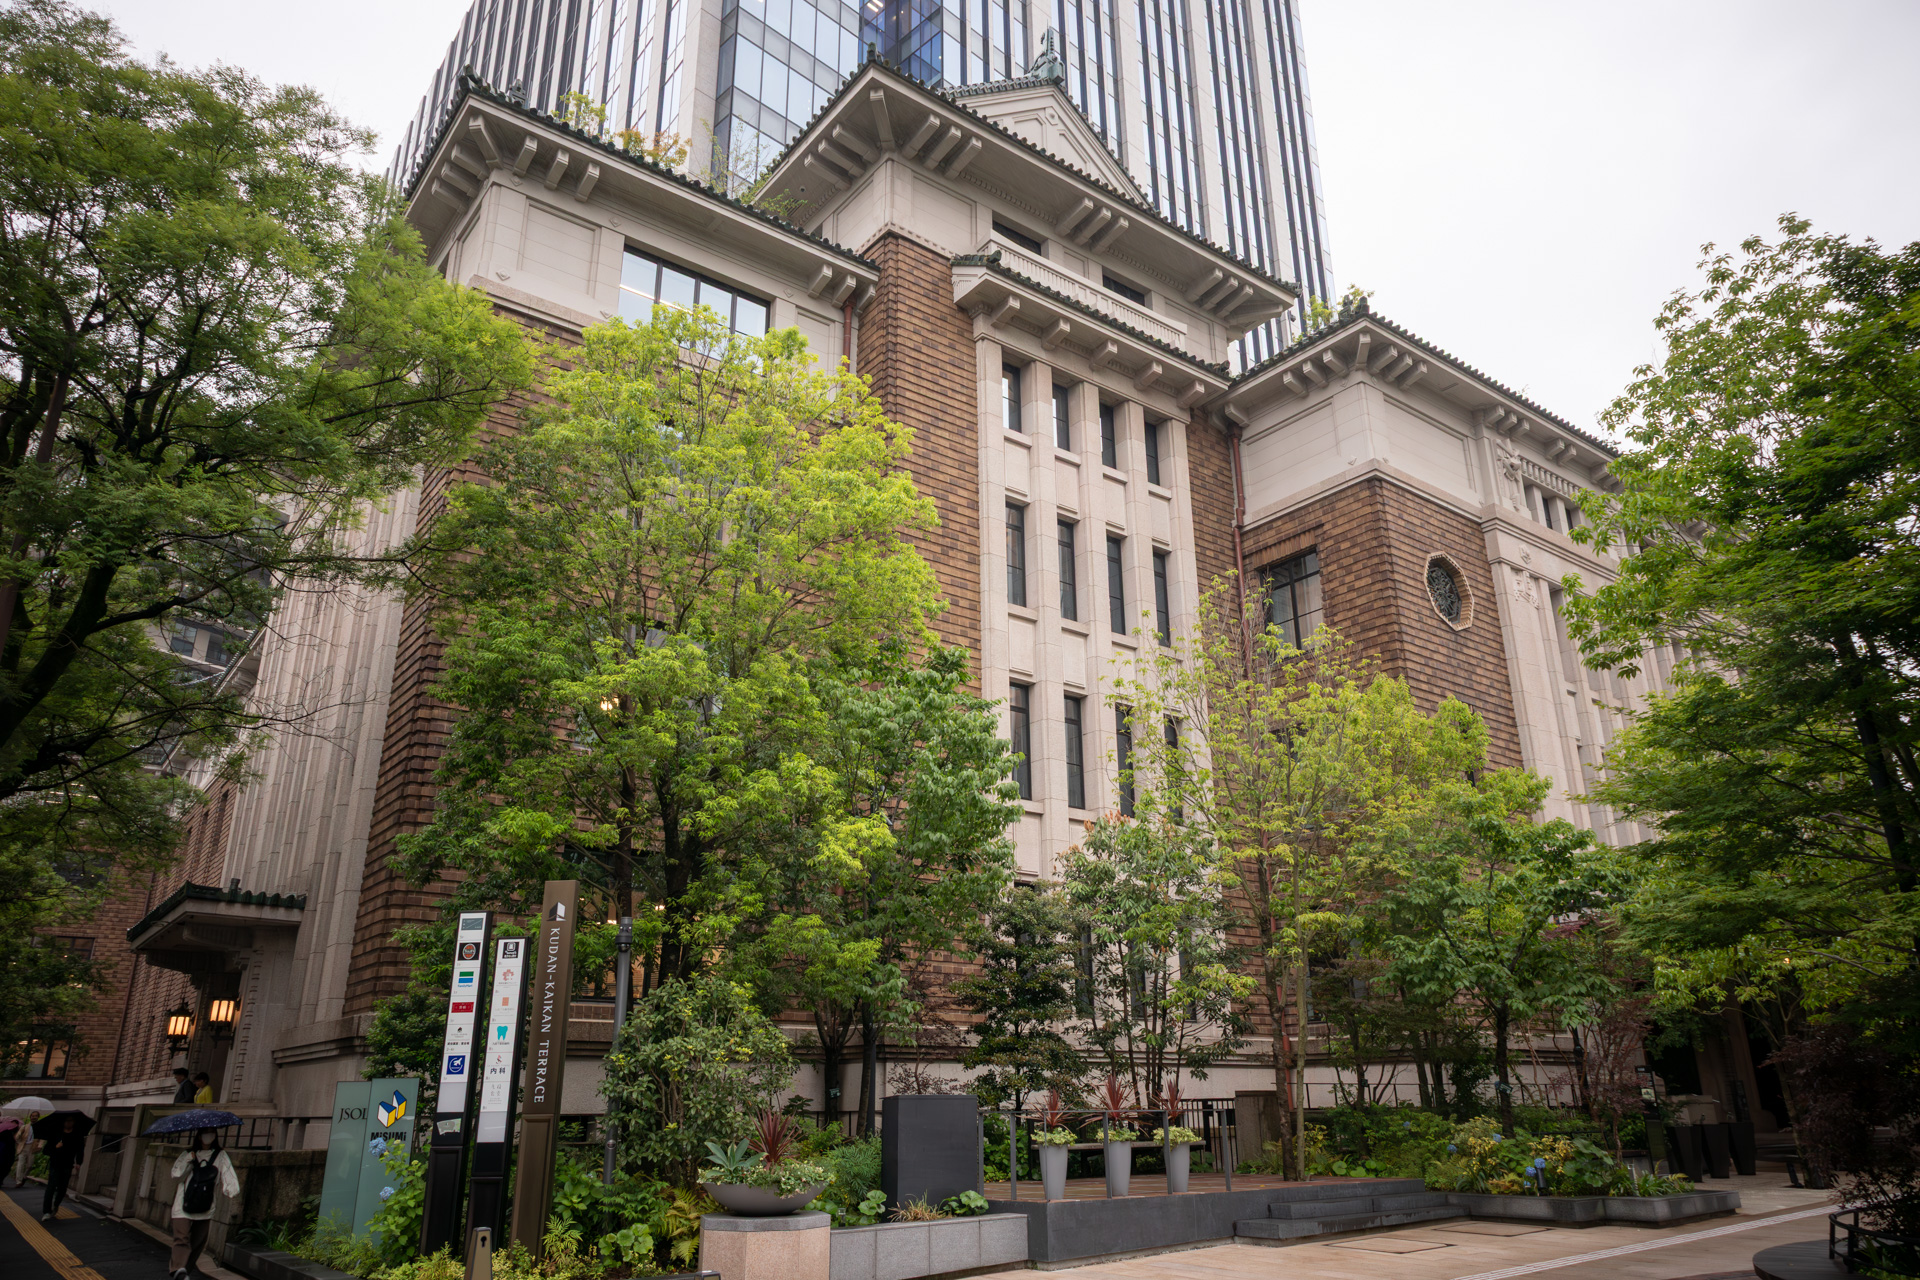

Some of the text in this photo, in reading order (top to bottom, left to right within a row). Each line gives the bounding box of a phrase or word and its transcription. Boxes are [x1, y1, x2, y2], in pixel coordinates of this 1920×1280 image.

[534, 928, 560, 1103] KUDAN-KAIKAN TERRACE
[338, 1108, 368, 1124] JSOL
